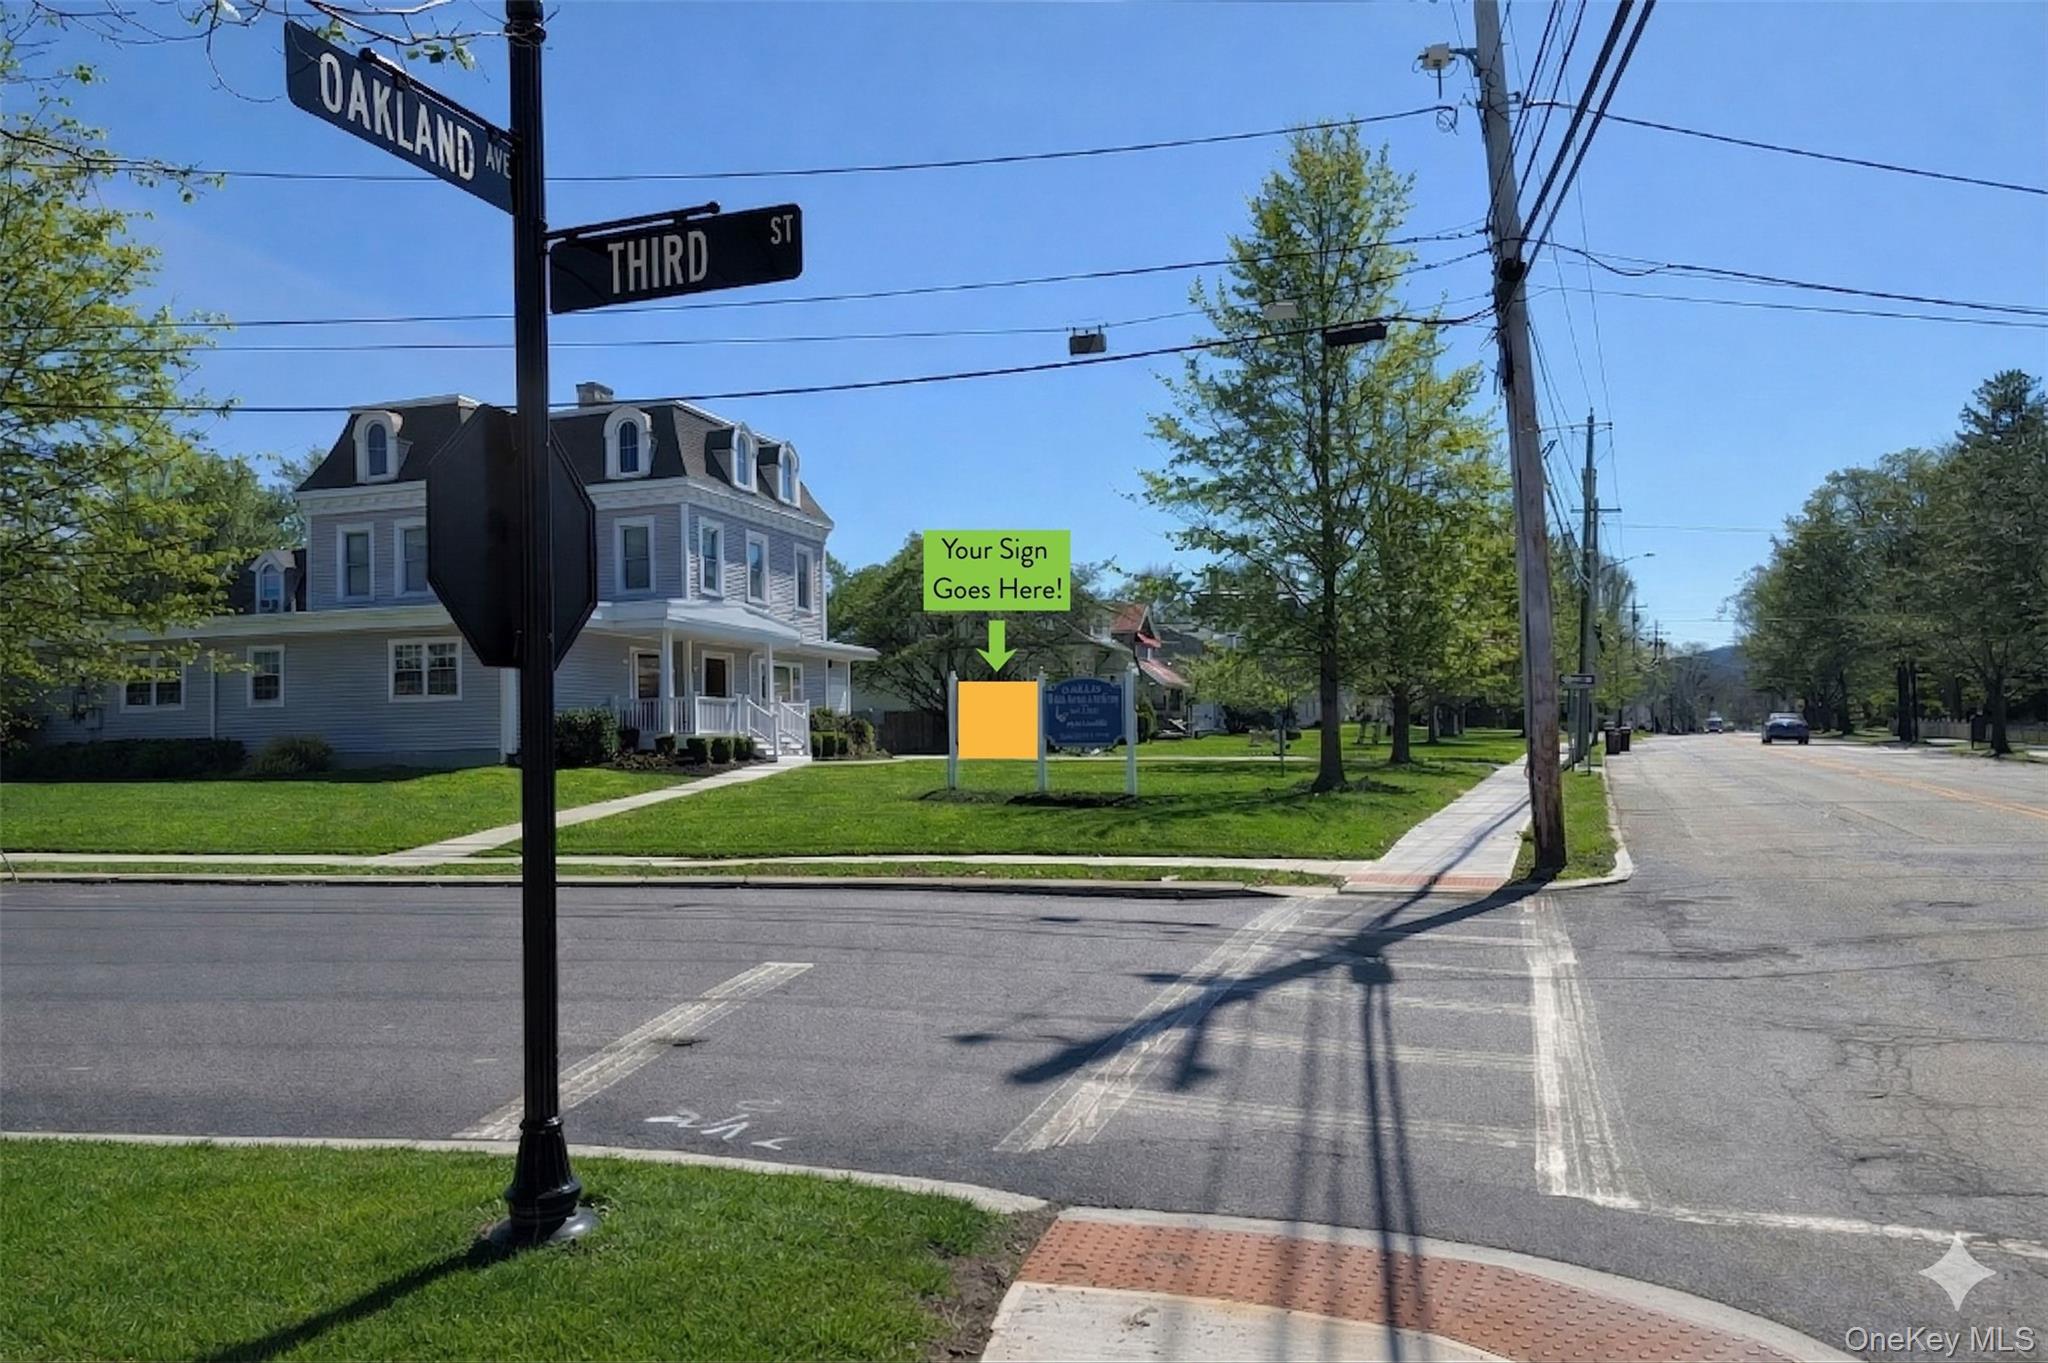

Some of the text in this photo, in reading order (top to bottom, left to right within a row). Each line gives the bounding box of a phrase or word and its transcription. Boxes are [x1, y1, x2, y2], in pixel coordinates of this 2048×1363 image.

[318, 51, 512, 181] OAKLAND AVE
[607, 213, 794, 294] THIRD ST
